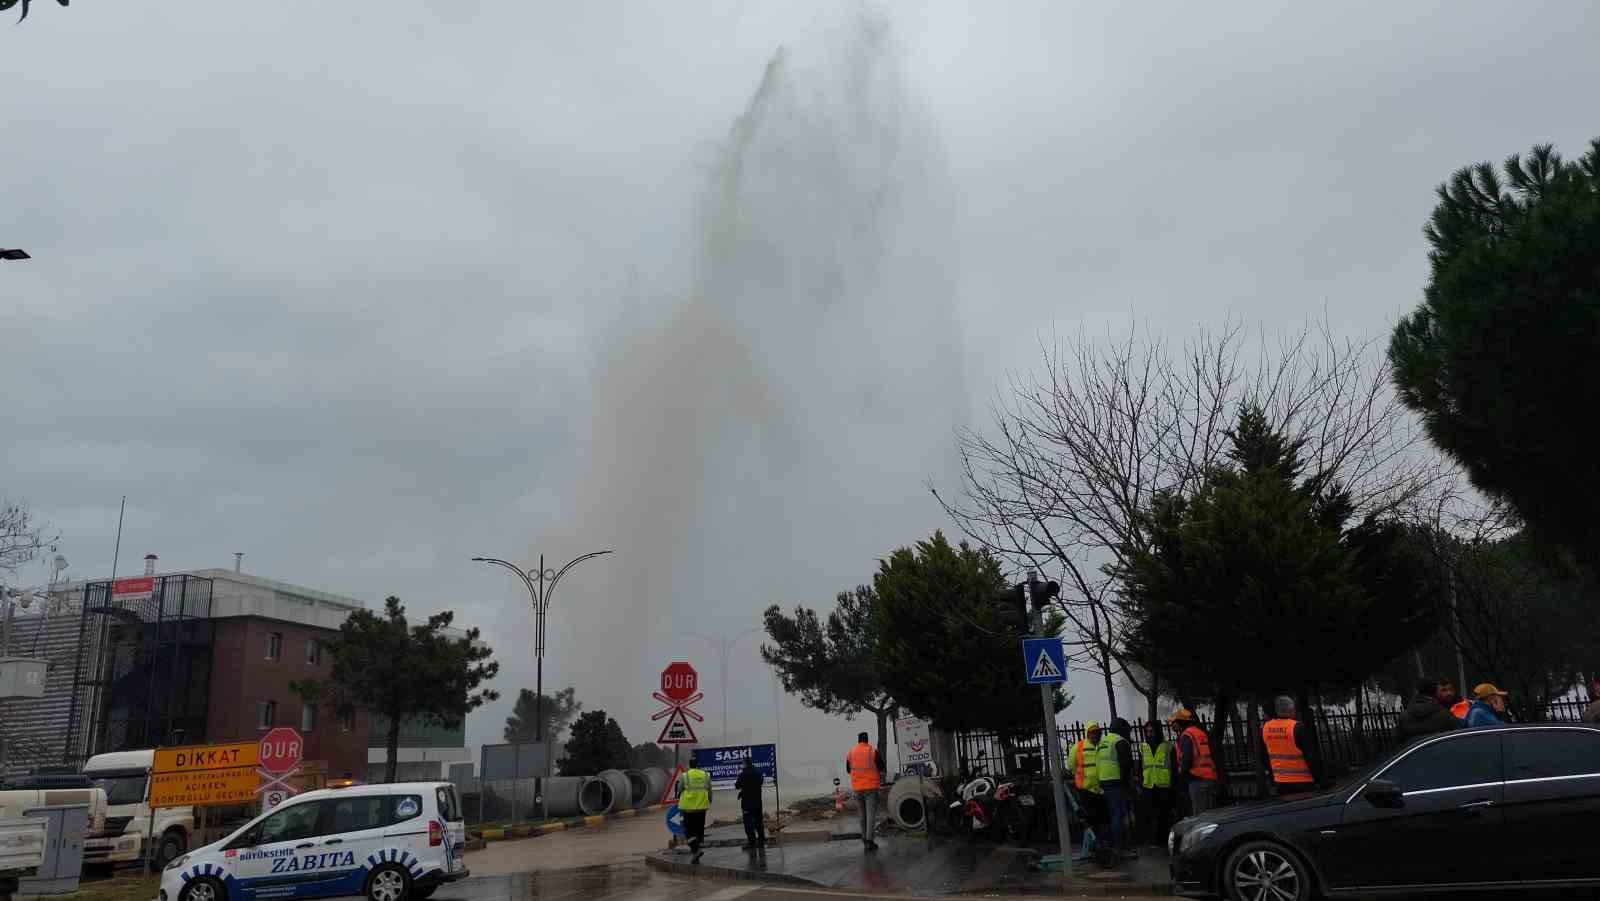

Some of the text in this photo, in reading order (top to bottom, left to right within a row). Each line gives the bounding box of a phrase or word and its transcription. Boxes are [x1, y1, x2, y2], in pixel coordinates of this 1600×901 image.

[664, 674, 694, 689] DUR
[262, 741, 299, 759] DUR
[271, 850, 355, 873] ZABITA
